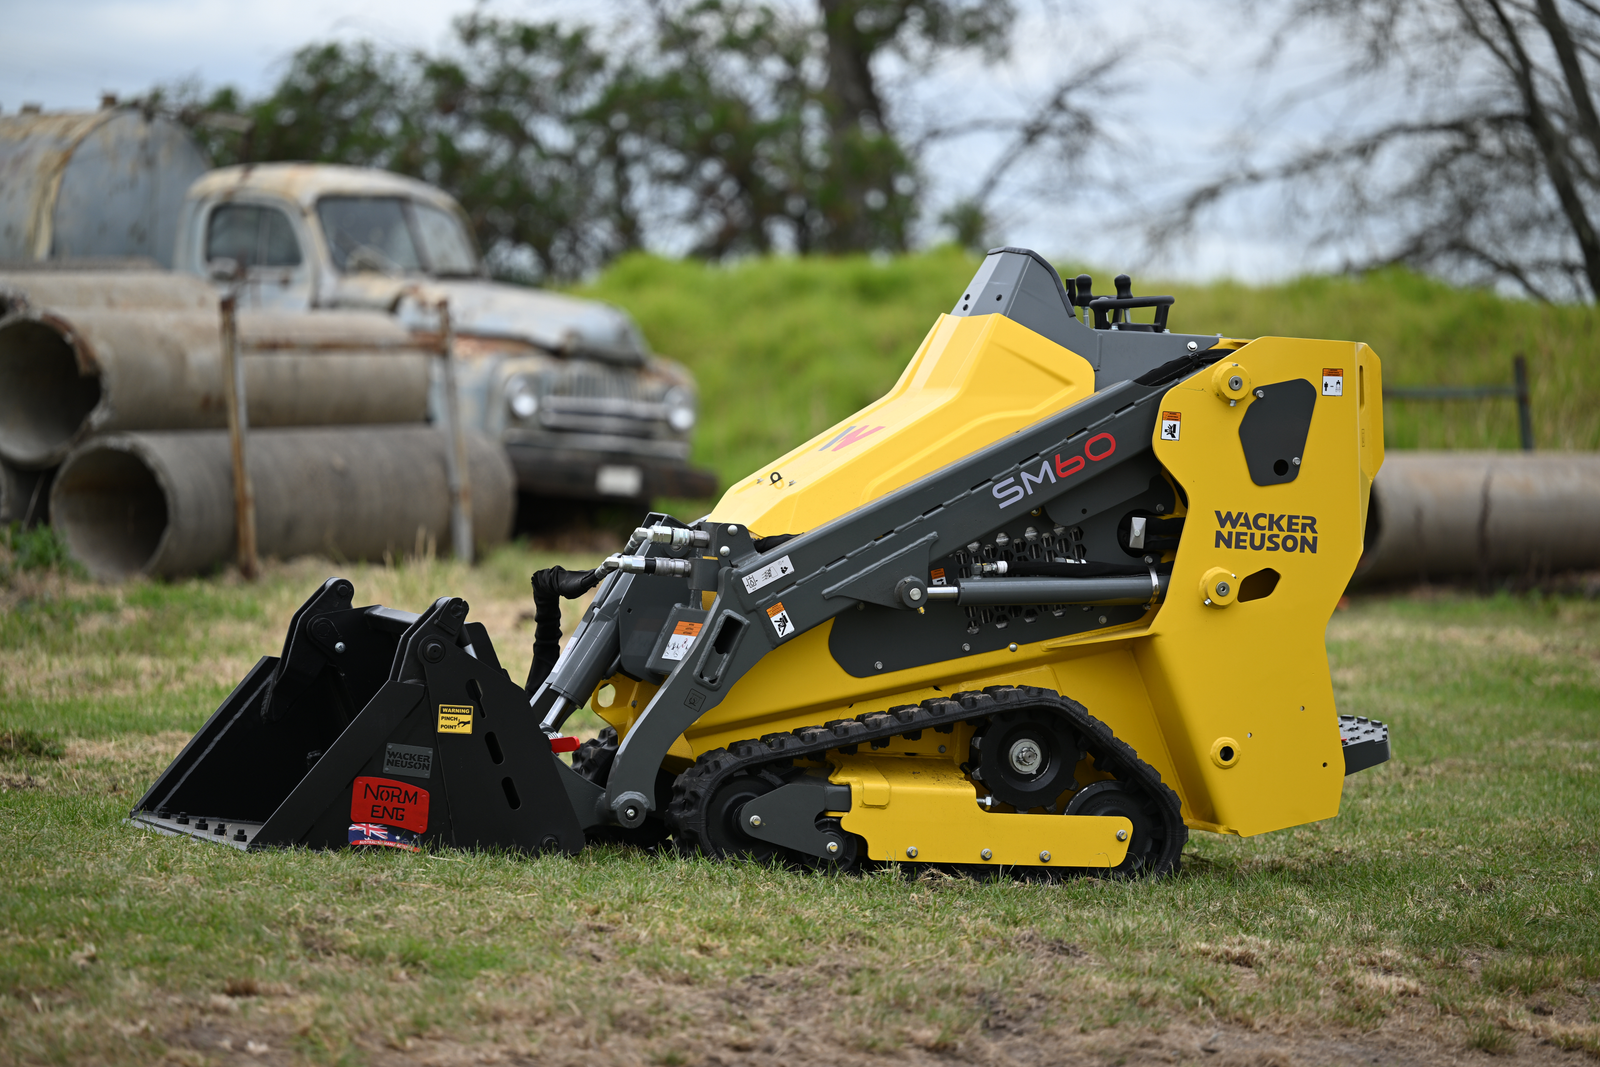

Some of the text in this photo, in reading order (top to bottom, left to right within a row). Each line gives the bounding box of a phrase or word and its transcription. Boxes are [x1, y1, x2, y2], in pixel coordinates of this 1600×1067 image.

[992, 432, 1116, 510] SM60
[1214, 510, 1318, 534] WACKER
[1214, 530, 1318, 554] NEUSON
[386, 750, 431, 764] WACKER
[386, 759, 430, 771] NEUSON
[364, 783, 418, 805] NORM
[371, 804, 406, 821] ENG
